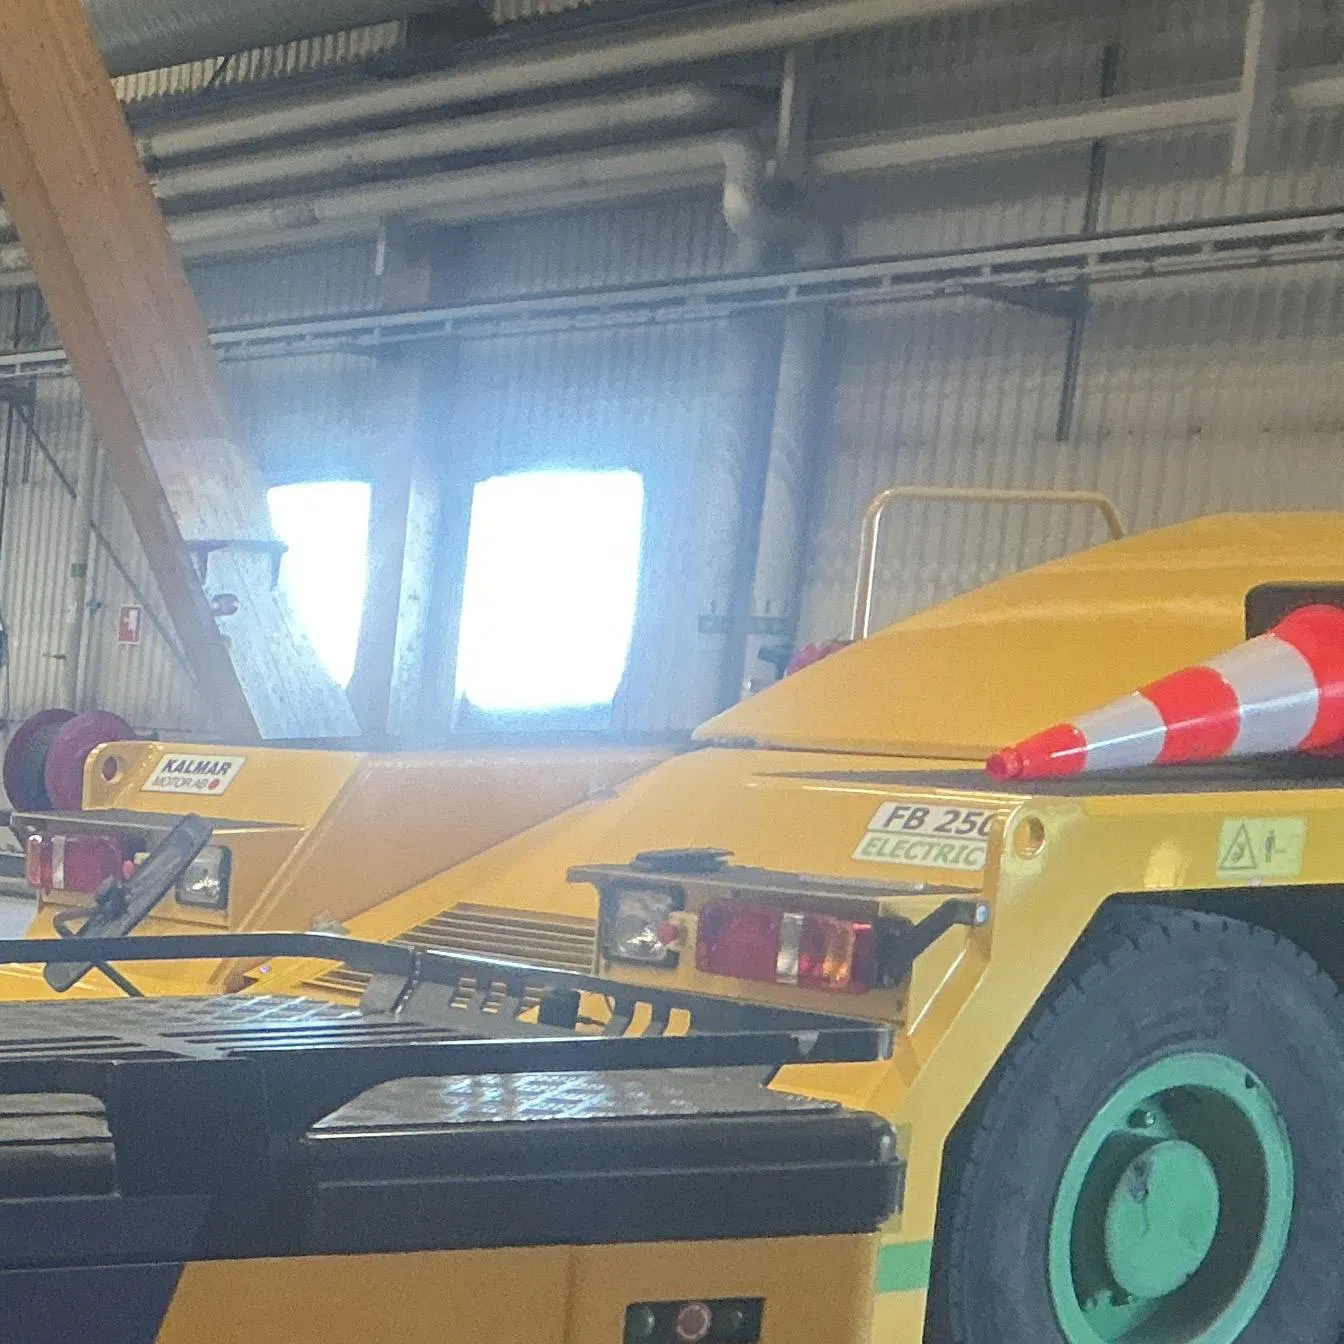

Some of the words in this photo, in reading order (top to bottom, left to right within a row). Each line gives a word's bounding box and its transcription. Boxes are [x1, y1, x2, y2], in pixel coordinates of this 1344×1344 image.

[161, 758, 233, 776] KALMAR
[152, 775, 192, 789] MOTOR
[192, 777, 209, 790] AB
[883, 804, 931, 831] FB
[861, 836, 985, 866] ELECTRIC
